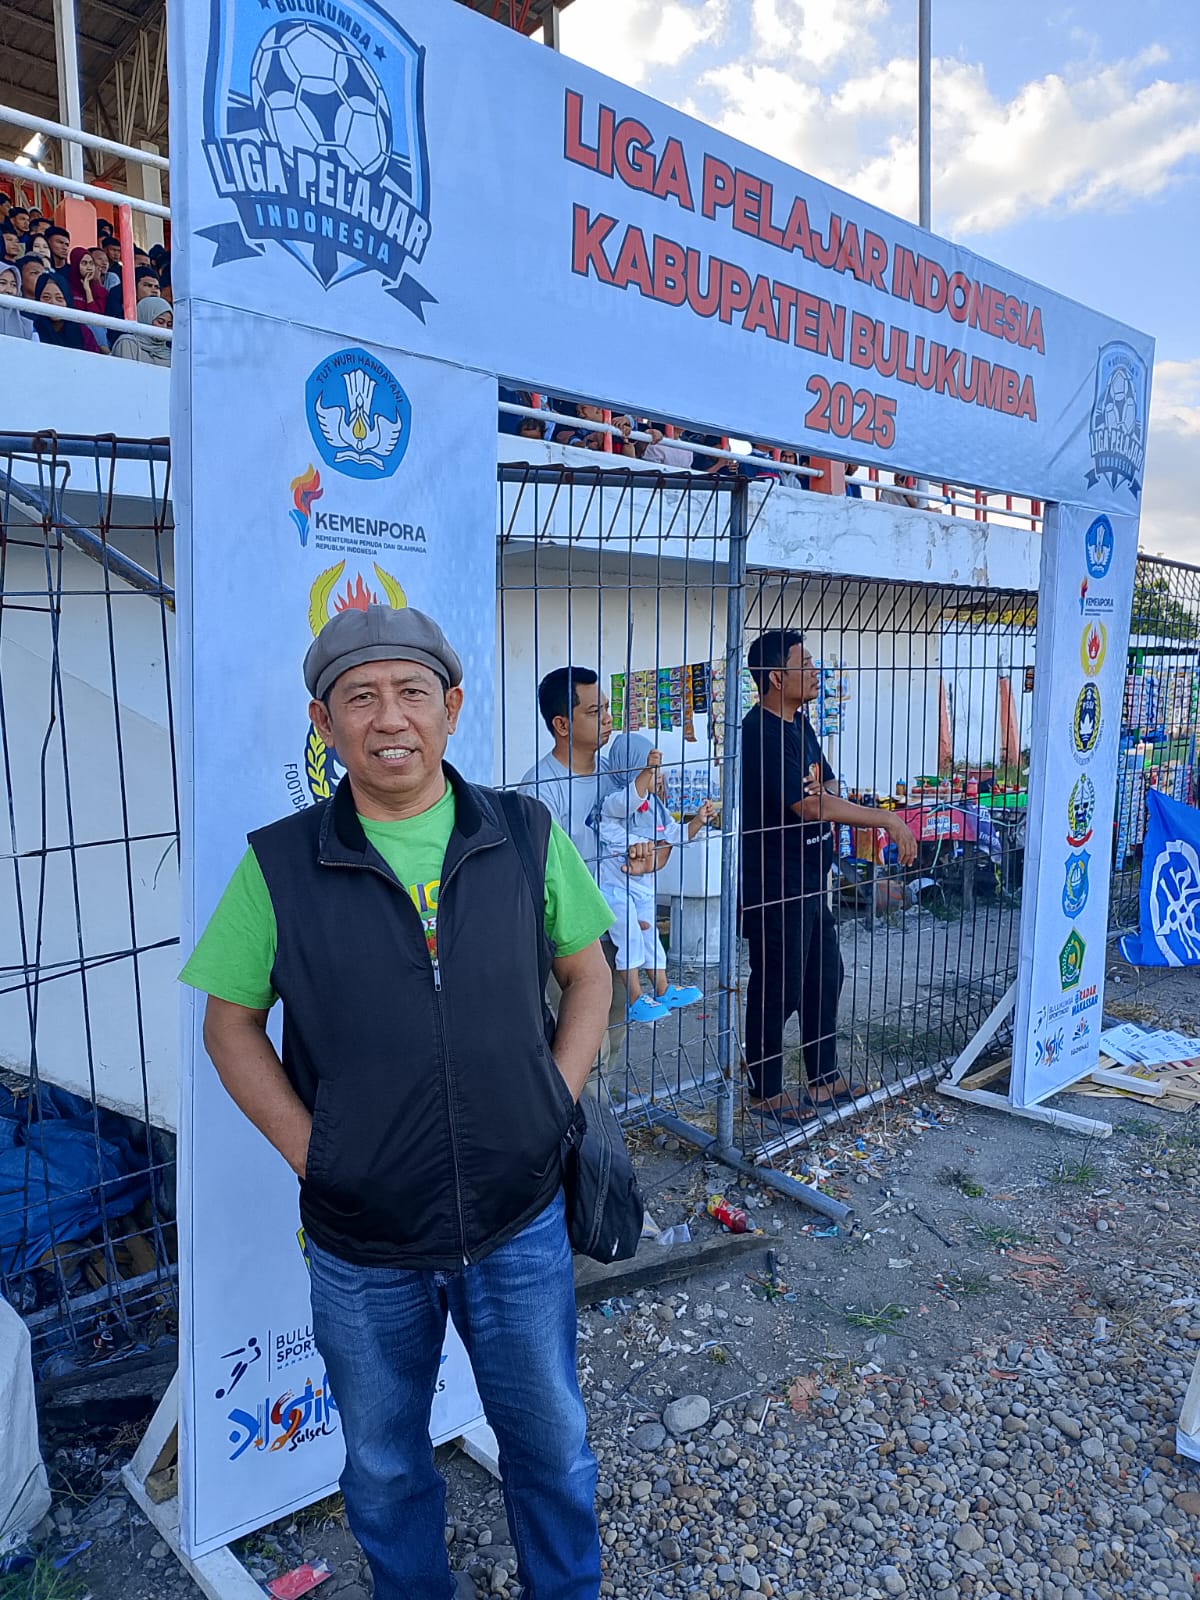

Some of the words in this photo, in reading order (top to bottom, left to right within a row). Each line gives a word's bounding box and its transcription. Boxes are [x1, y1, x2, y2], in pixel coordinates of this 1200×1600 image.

[275, 0, 371, 50] BULUKUMBA
[206, 140, 288, 195] LIGA
[297, 150, 428, 257] PELAJAR
[564, 88, 695, 212] LIGA
[702, 153, 889, 294] PELAJAR
[893, 244, 1045, 355] INDONESIA
[255, 203, 389, 264] INDONESIA
[572, 203, 845, 361] KABUPATEN
[850, 310, 1037, 422] BULUKUMBA
[316, 362, 332, 383] TUT
[333, 354, 355, 367] WURI
[358, 354, 403, 403] HANDAYANI
[805, 374, 897, 449] 2025
[315, 511, 426, 543] KEMENPORA
[276, 1325, 314, 1350] BULU
